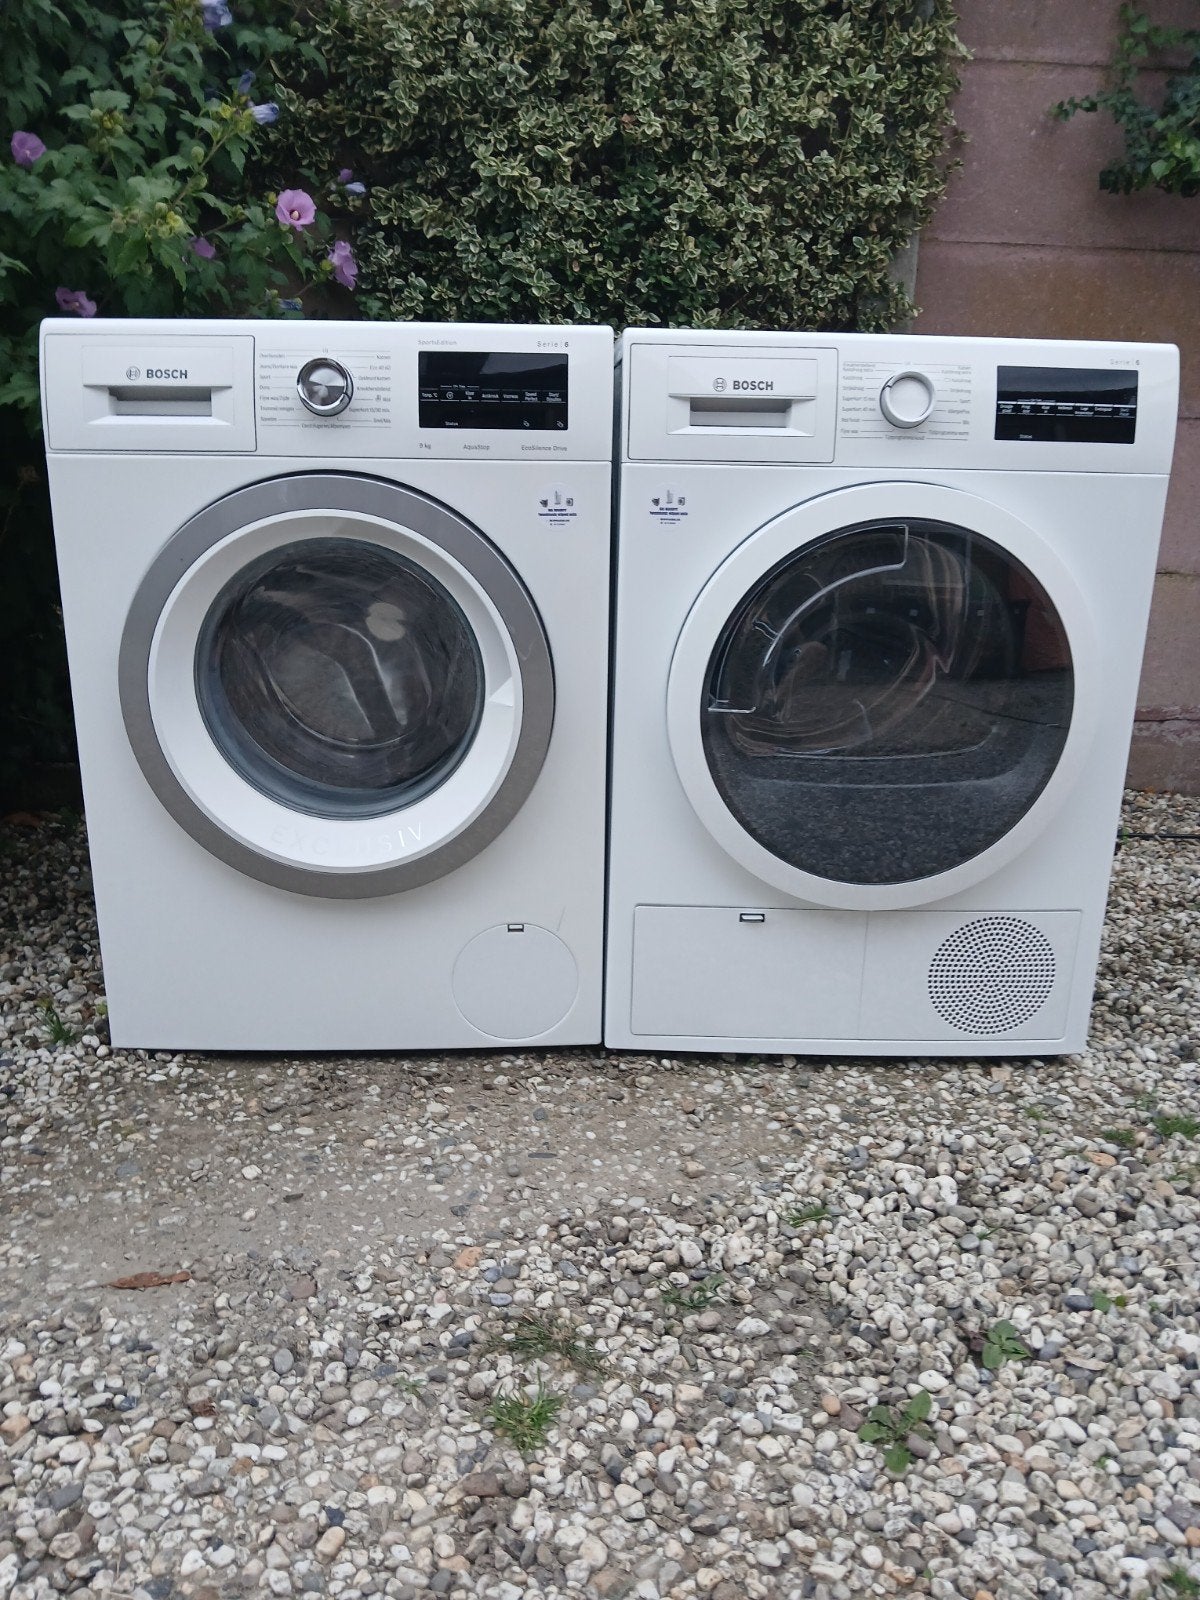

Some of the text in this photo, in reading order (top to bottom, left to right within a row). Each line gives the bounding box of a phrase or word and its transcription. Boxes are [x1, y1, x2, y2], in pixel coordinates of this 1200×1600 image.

[537, 340, 559, 348] Serie
[146, 369, 188, 379] BOSCH
[733, 380, 774, 391] BOSCH
[463, 443, 490, 451] AquaStop
[521, 444, 568, 452] EcoSilence Drive
